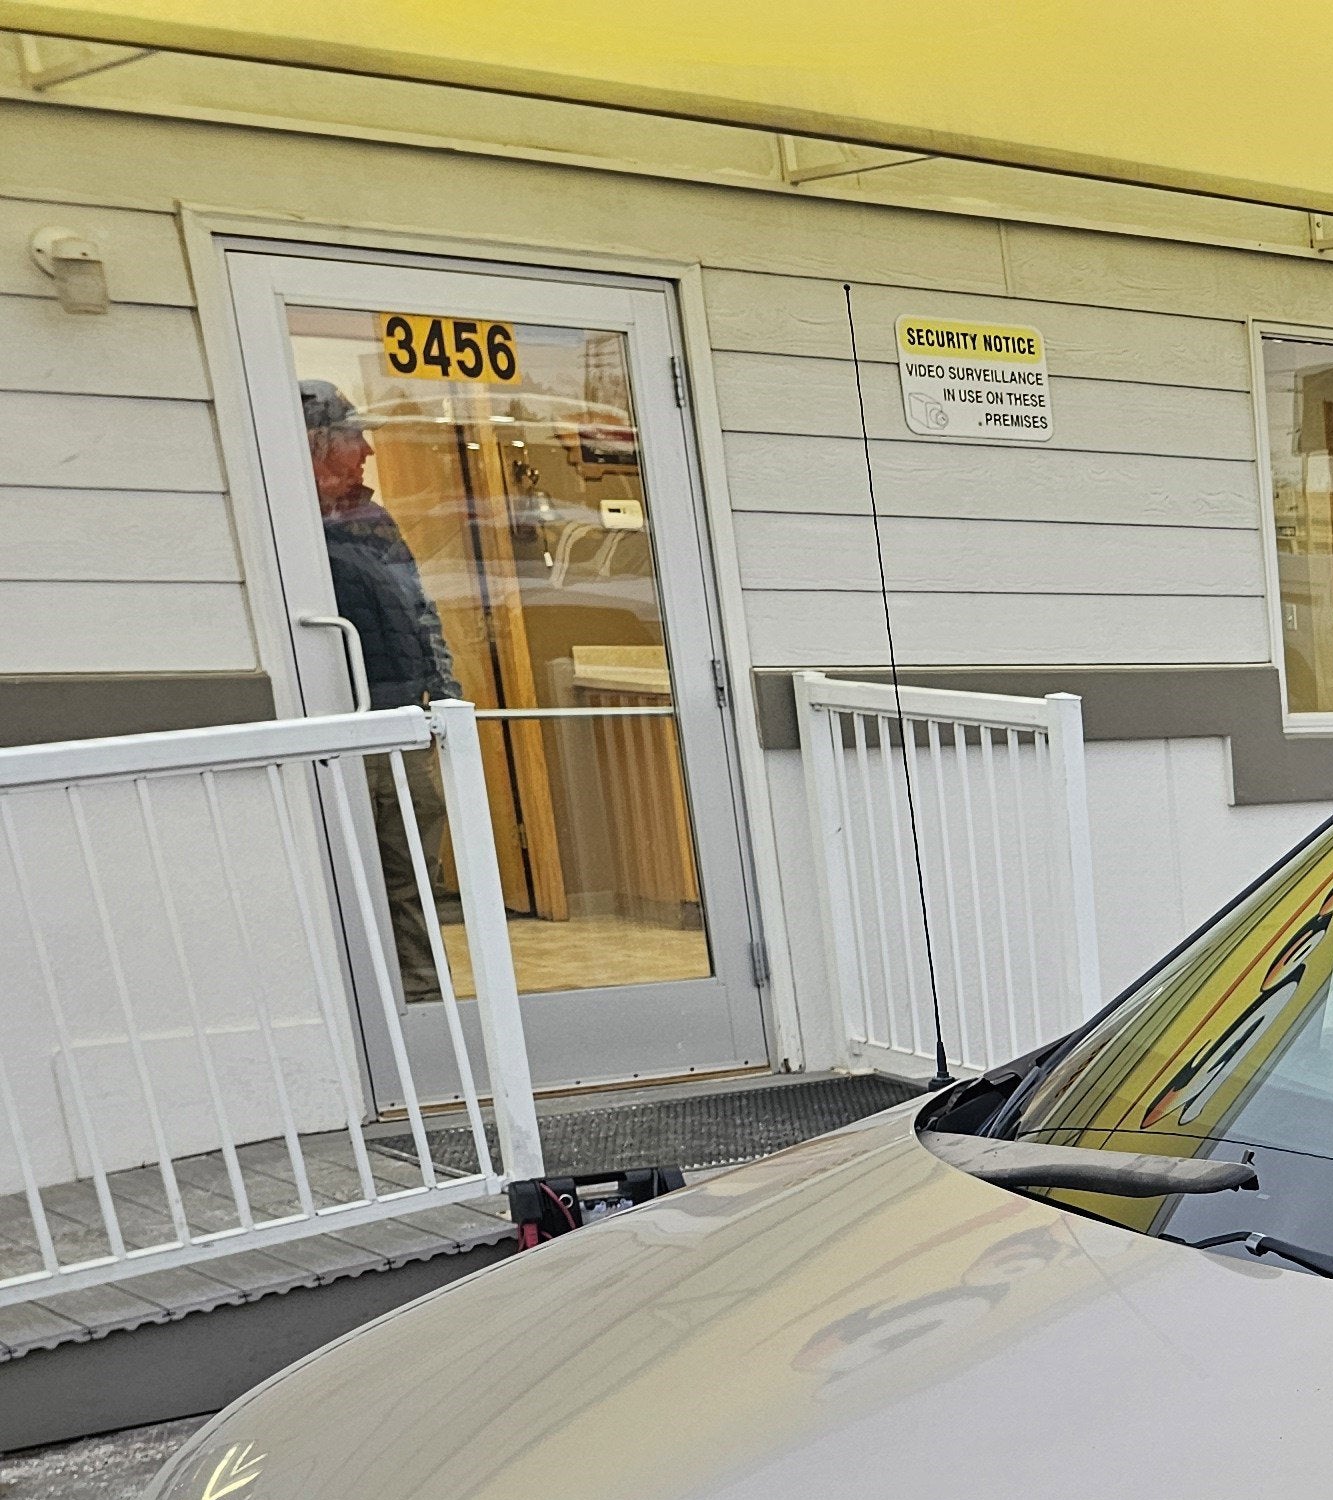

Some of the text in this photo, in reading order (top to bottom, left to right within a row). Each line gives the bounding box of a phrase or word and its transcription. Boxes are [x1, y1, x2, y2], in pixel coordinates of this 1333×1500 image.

[386, 316, 516, 380] 3456
[906, 327, 1036, 355] SECURITY NOTICE
[905, 363, 1044, 386] VIDEO SURVEILLANCE
[943, 388, 1046, 408] IN USE ON THESE
[985, 412, 1048, 429] PREMISES
